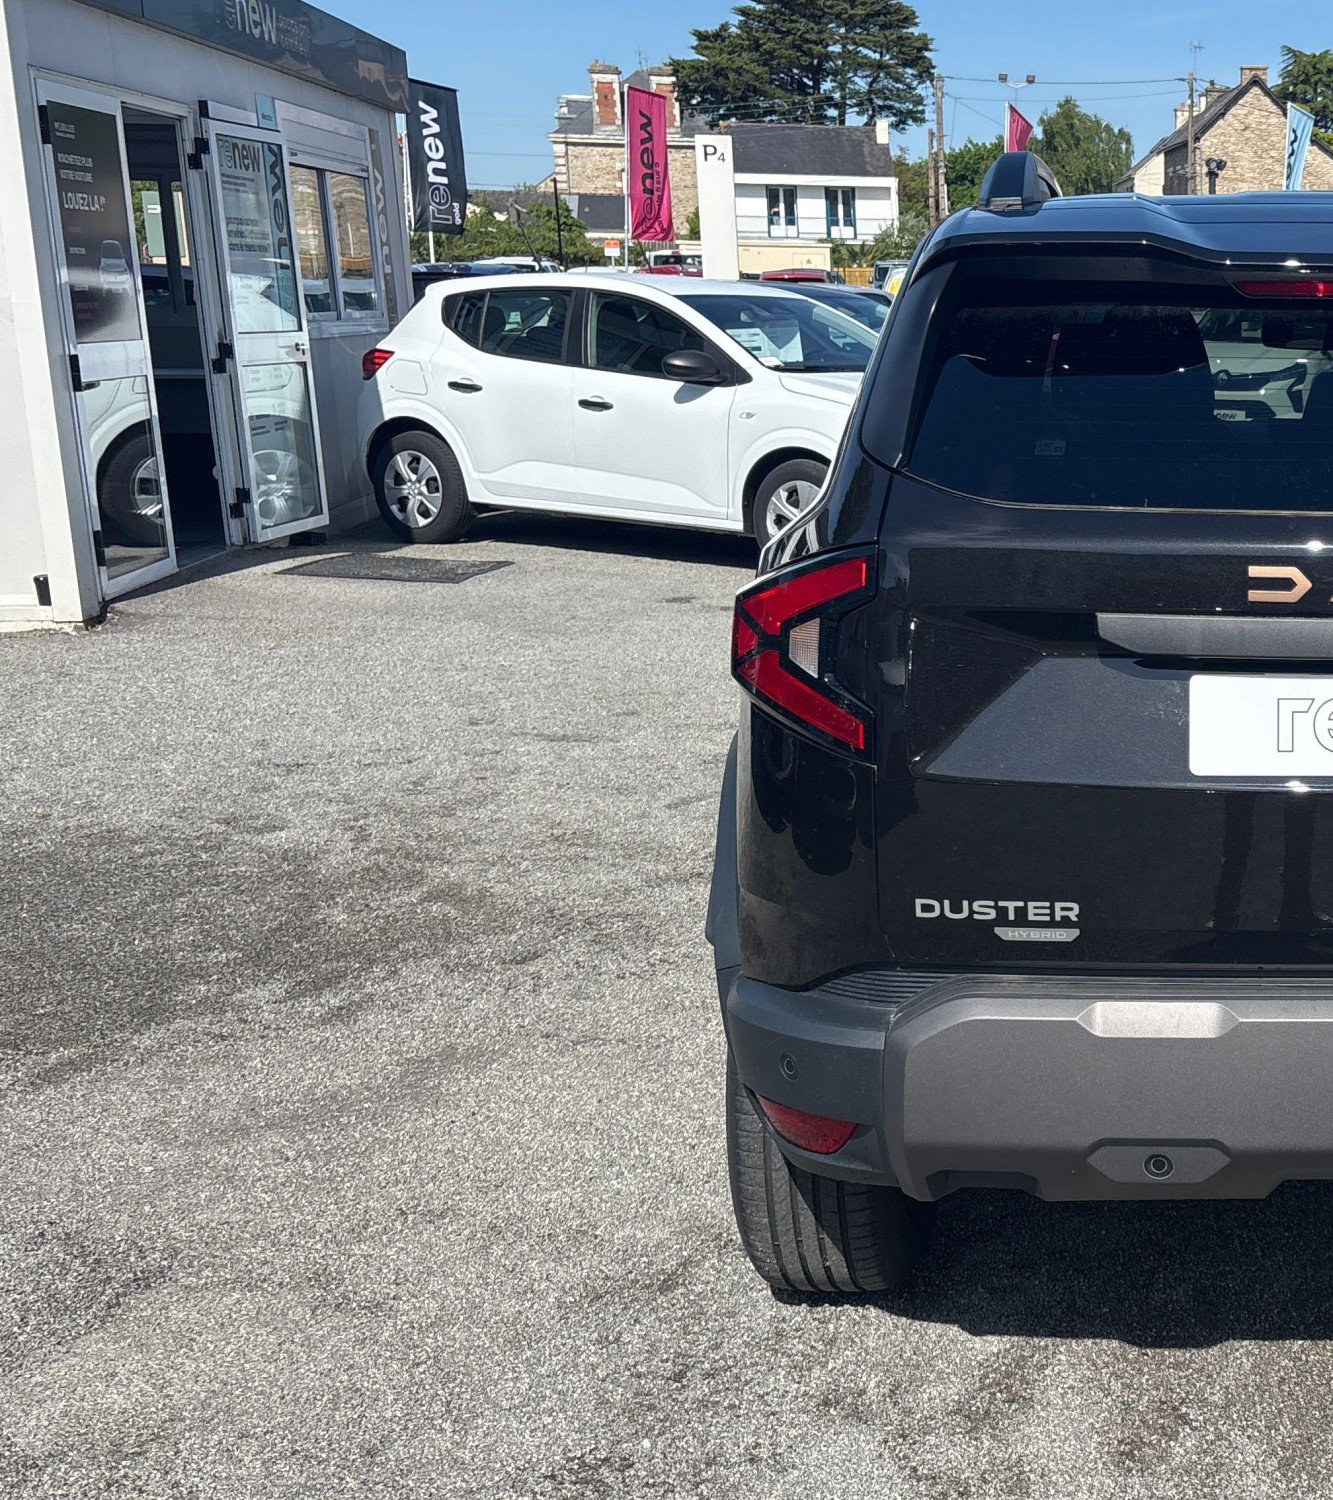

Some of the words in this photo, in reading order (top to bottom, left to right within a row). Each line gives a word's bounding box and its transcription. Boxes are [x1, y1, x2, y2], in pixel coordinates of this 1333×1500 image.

[216, 138, 261, 173] renew
[418, 100, 453, 225] renew
[638, 109, 660, 234] renew
[62, 191, 89, 211] LOUEZ
[88, 194, 101, 212] LA
[452, 202, 462, 226] gold
[1215, 411, 1238, 420] new
[914, 898, 1081, 922] DUSTER
[1008, 929, 1068, 940] HYBRID
